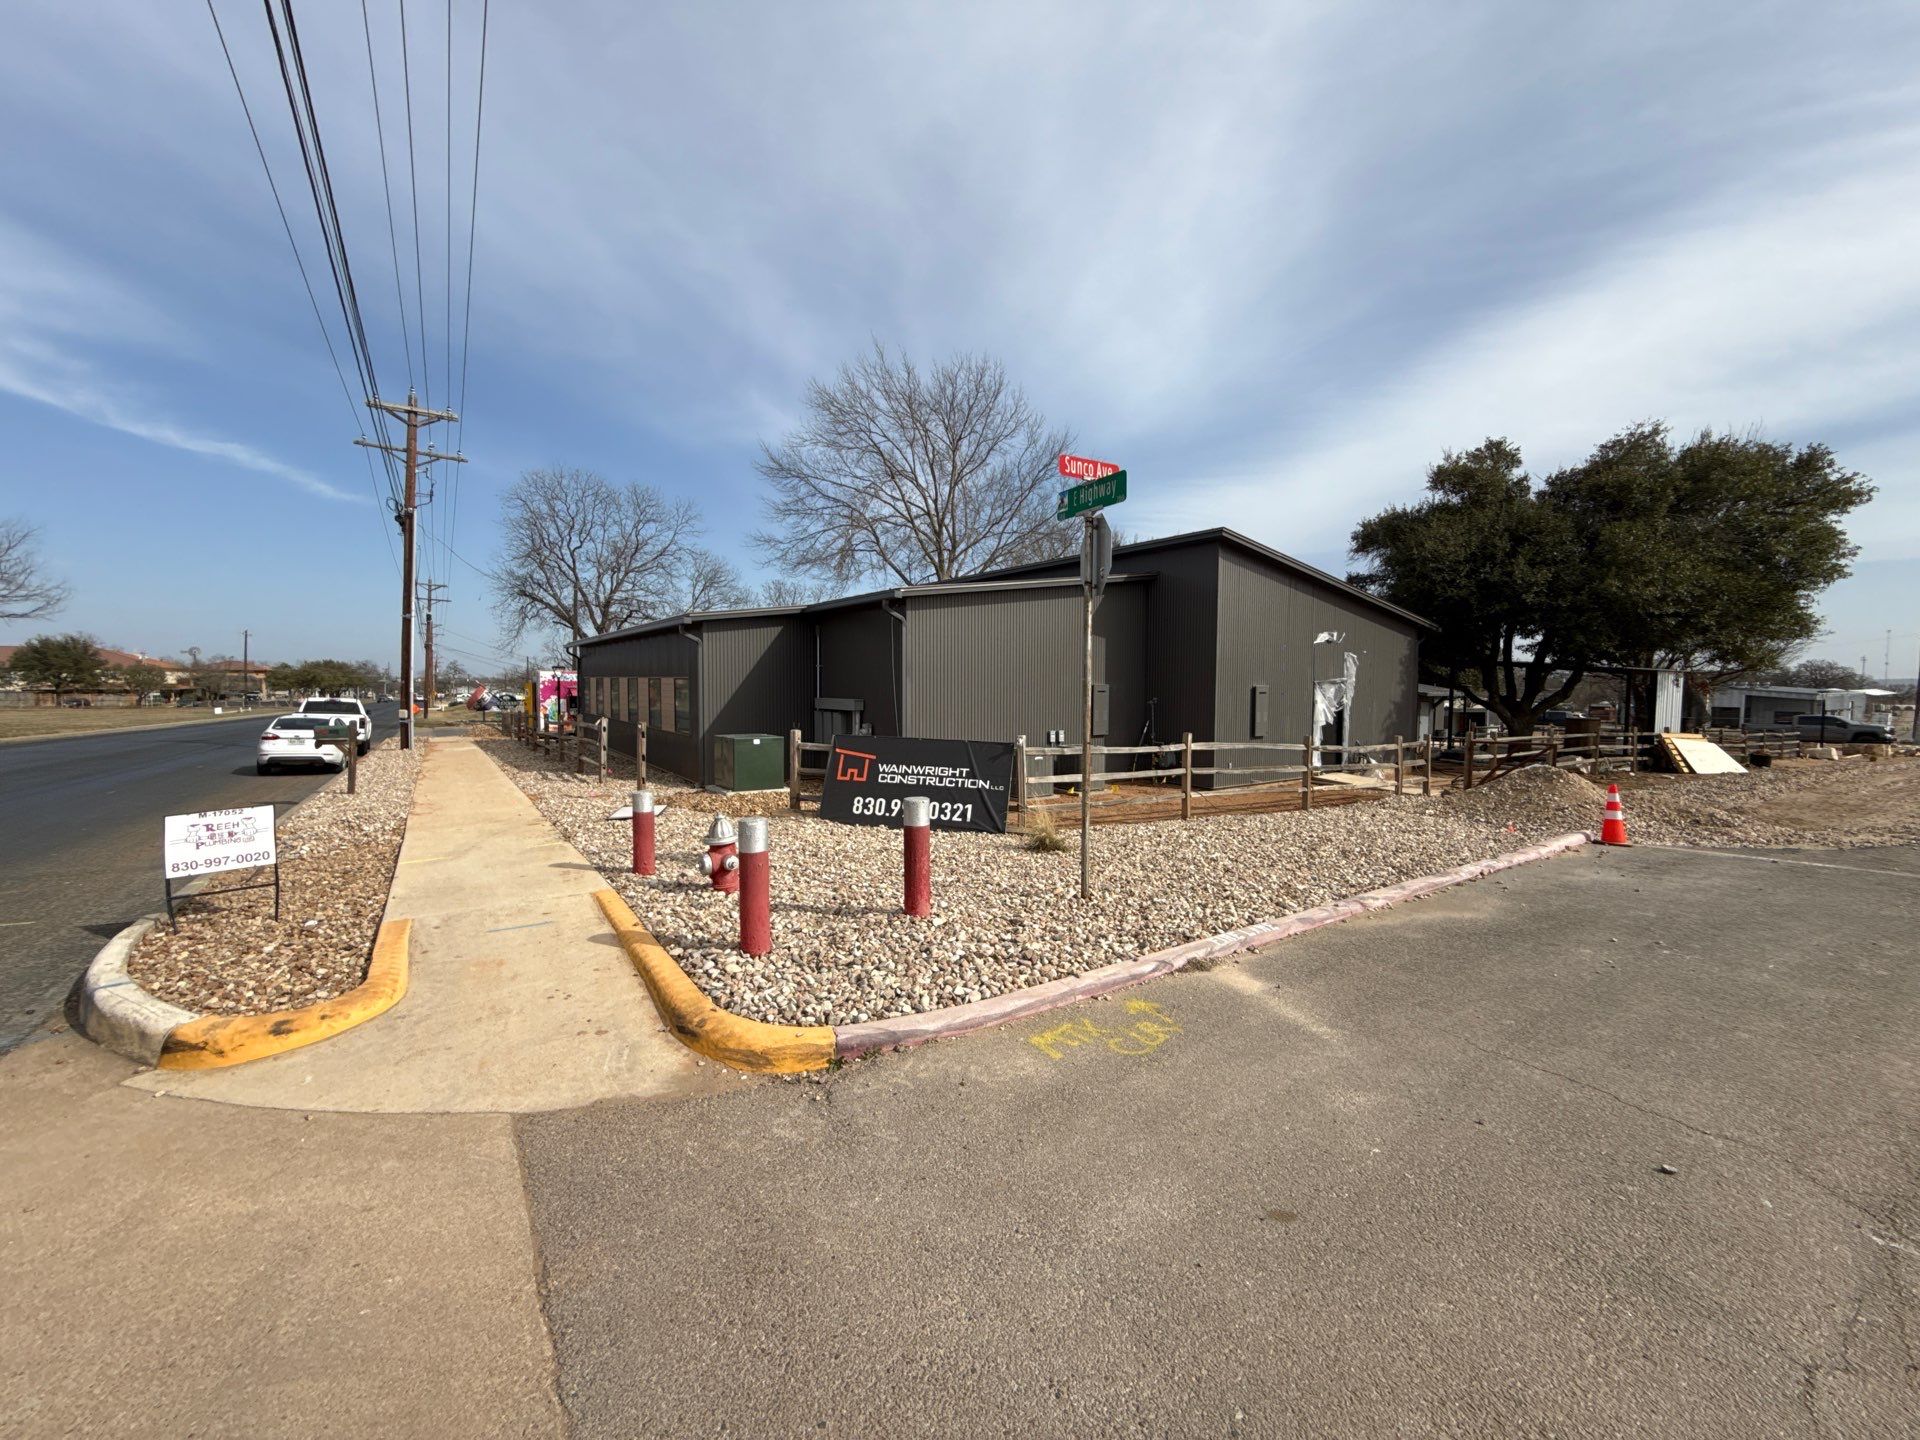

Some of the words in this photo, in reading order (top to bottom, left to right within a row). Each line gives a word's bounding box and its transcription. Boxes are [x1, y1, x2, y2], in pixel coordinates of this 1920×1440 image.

[1064, 455, 1094, 478] Sunco
[1096, 462, 1113, 479] Ave
[1073, 490, 1078, 507] E
[1079, 479, 1117, 507] Highway
[877, 763, 970, 778] WAINWRIGHT
[877, 773, 990, 790] CONSTRUCTION
[198, 808, 245, 819] M-17052
[202, 821, 240, 833] REEH
[195, 836, 242, 850] PLUMBING
[171, 850, 271, 873] 830-997-0020
